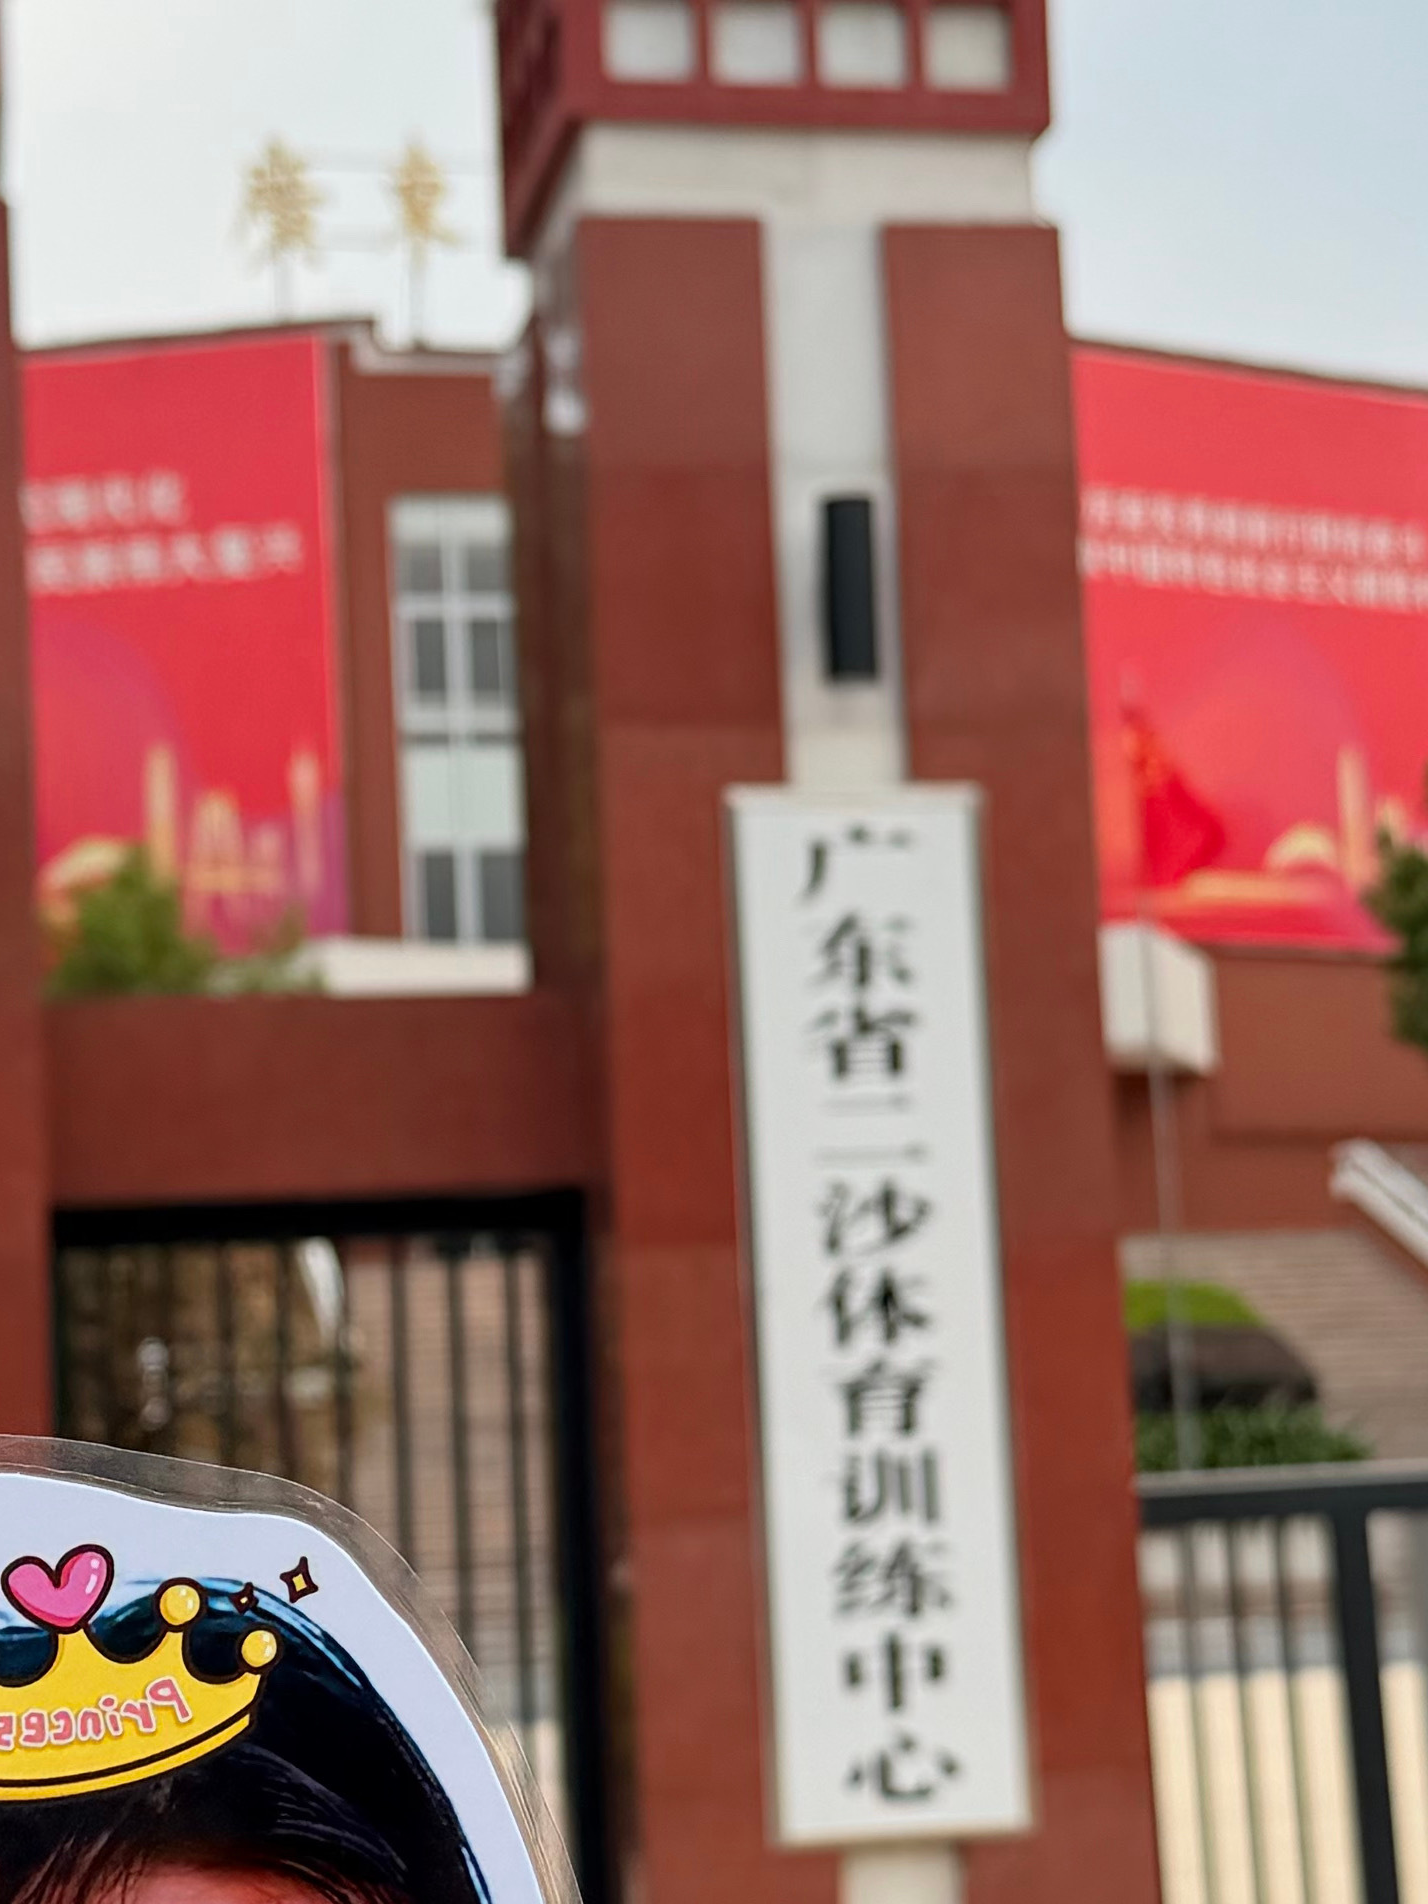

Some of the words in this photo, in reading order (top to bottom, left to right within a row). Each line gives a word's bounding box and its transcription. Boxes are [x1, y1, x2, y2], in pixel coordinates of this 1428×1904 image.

[798, 823, 963, 1802] 广东省二沙体育训练中心
